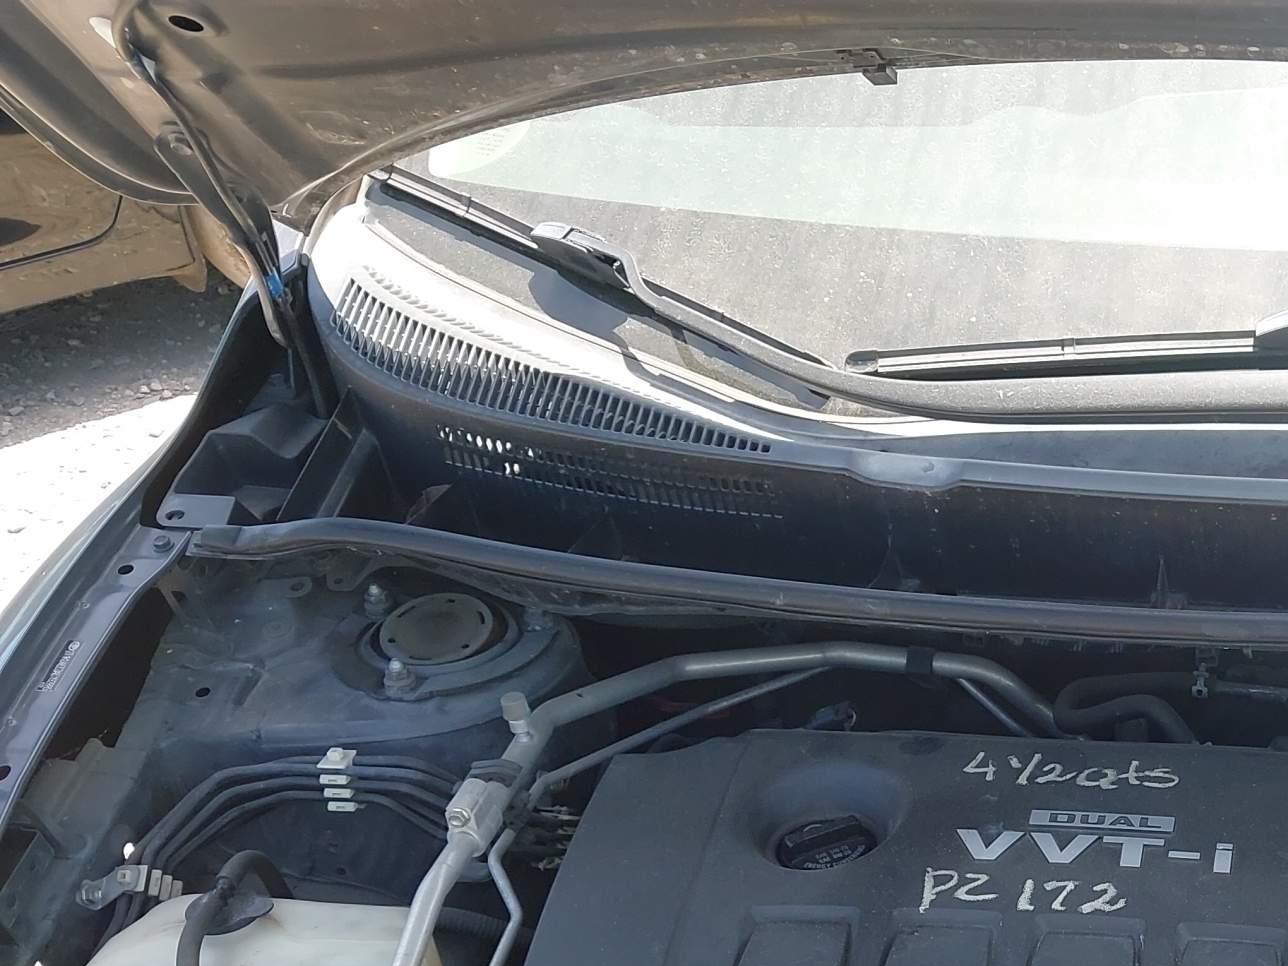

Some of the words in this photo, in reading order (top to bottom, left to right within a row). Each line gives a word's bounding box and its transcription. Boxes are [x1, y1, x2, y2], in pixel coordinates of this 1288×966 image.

[962, 751, 997, 781] 4
[1049, 812, 1162, 829] DUAL
[956, 828, 1234, 873] VVT-i
[1016, 879, 1127, 914] 172
